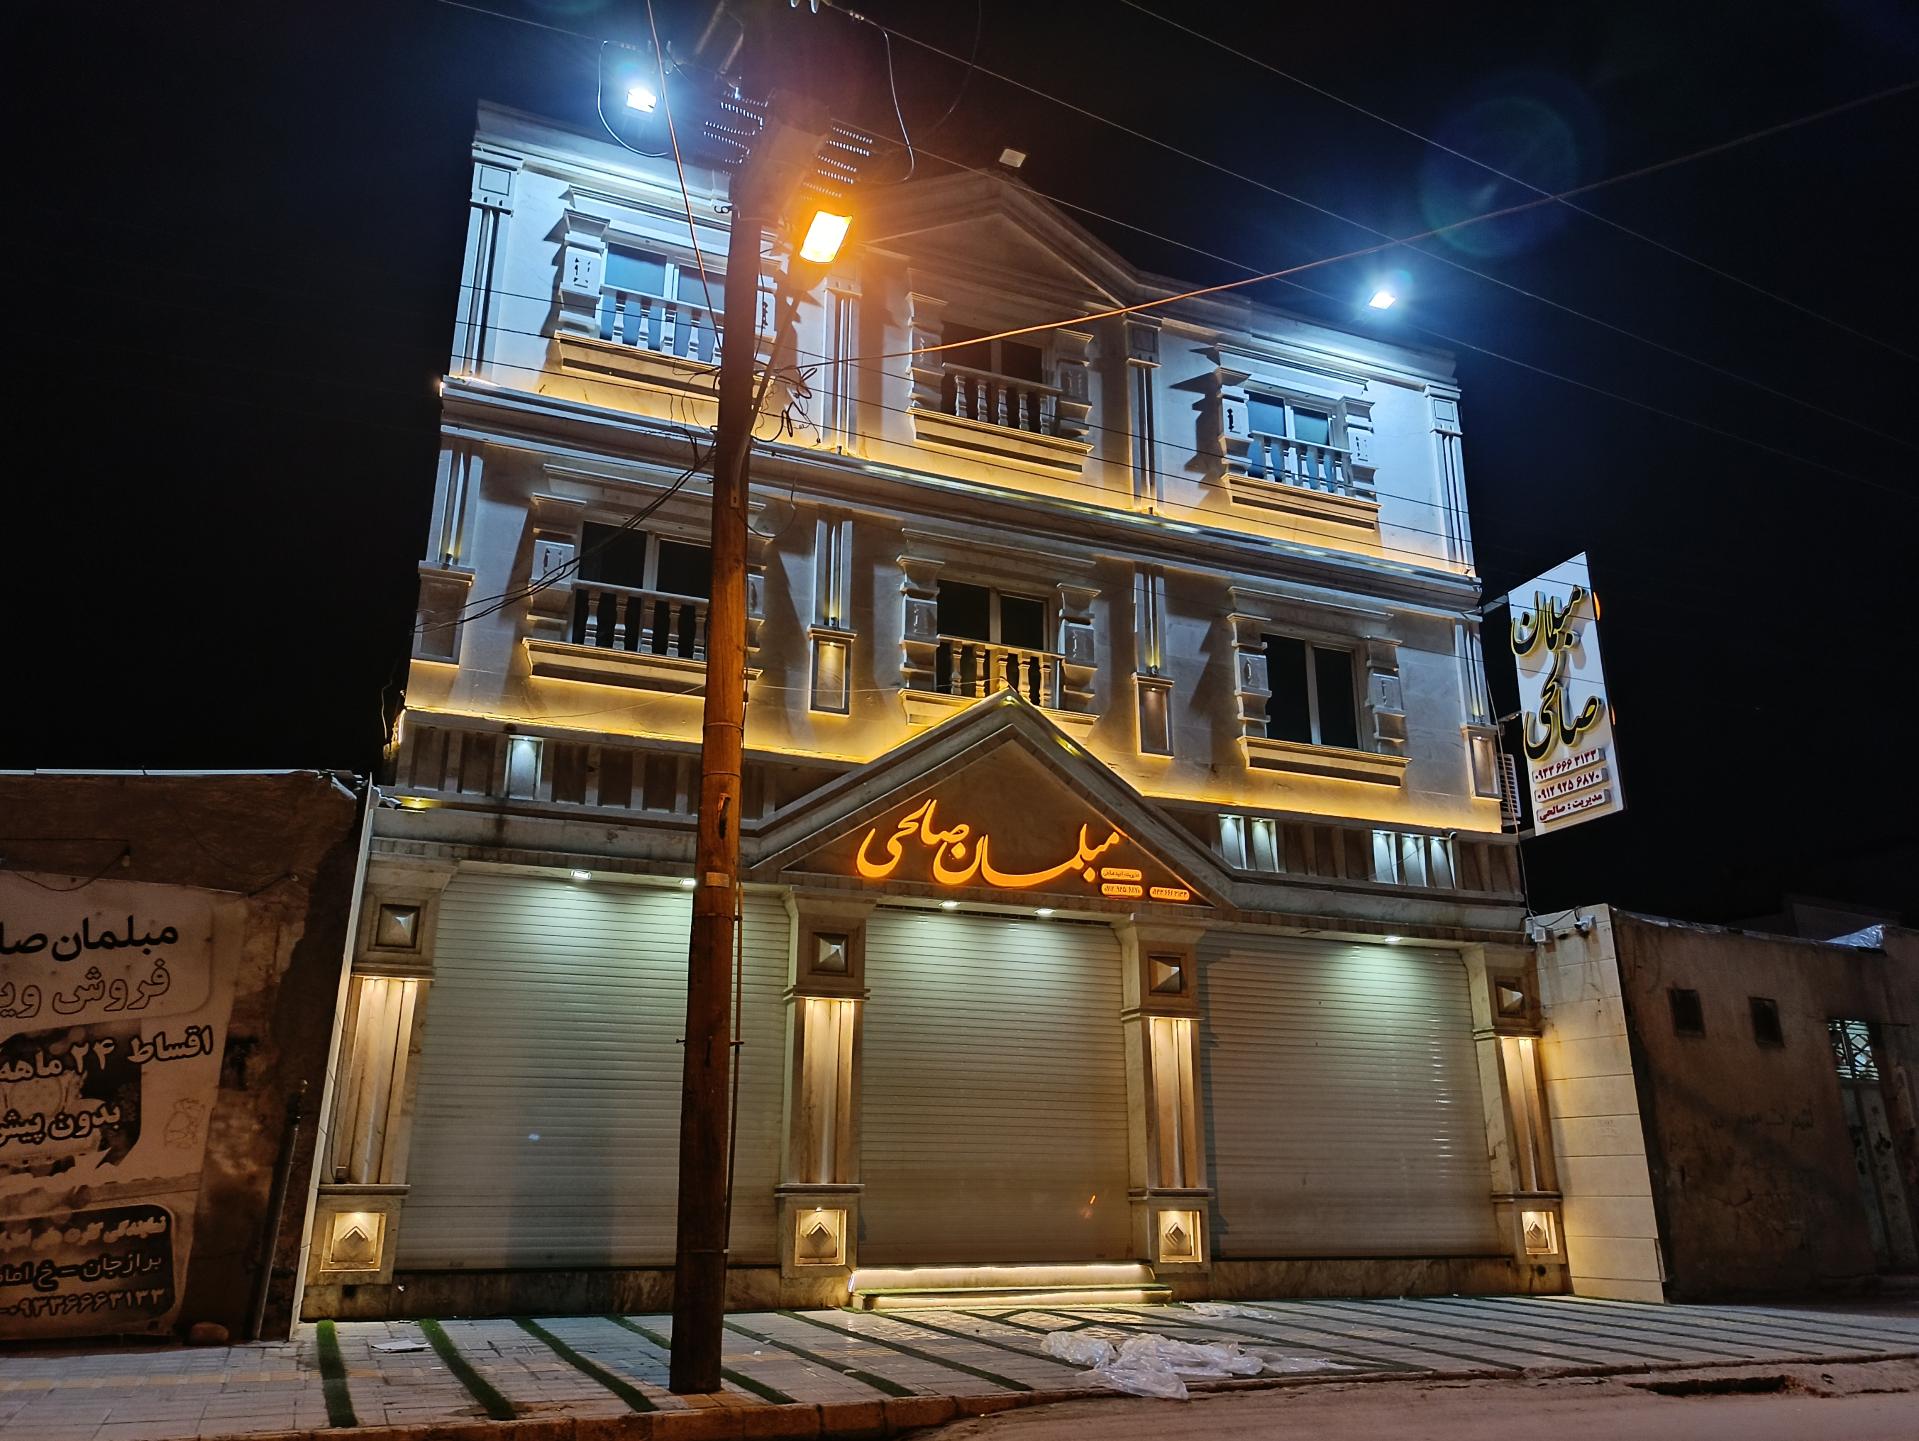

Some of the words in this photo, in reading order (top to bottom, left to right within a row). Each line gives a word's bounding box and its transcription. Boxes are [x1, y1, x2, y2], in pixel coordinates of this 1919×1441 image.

[1511, 585, 1585, 656] مبلمان
[1524, 651, 1604, 760] صالحی
[1538, 785, 1555, 799] ۰۹۱۲
[1576, 771, 1600, 788] ۶۸۷۰
[1556, 759, 1572, 774] ۶۶۶
[856, 798, 970, 878] صالحی
[933, 823, 1120, 888] مبلمان
[52, 915, 178, 962] مبلمان
[52, 958, 171, 1014] فروش
[69, 1037, 116, 1075] ۲۴
[128, 1025, 214, 1064] اقساط
[48, 1105, 121, 1140] بدون
[82, 1253, 162, 1278] برازجان
